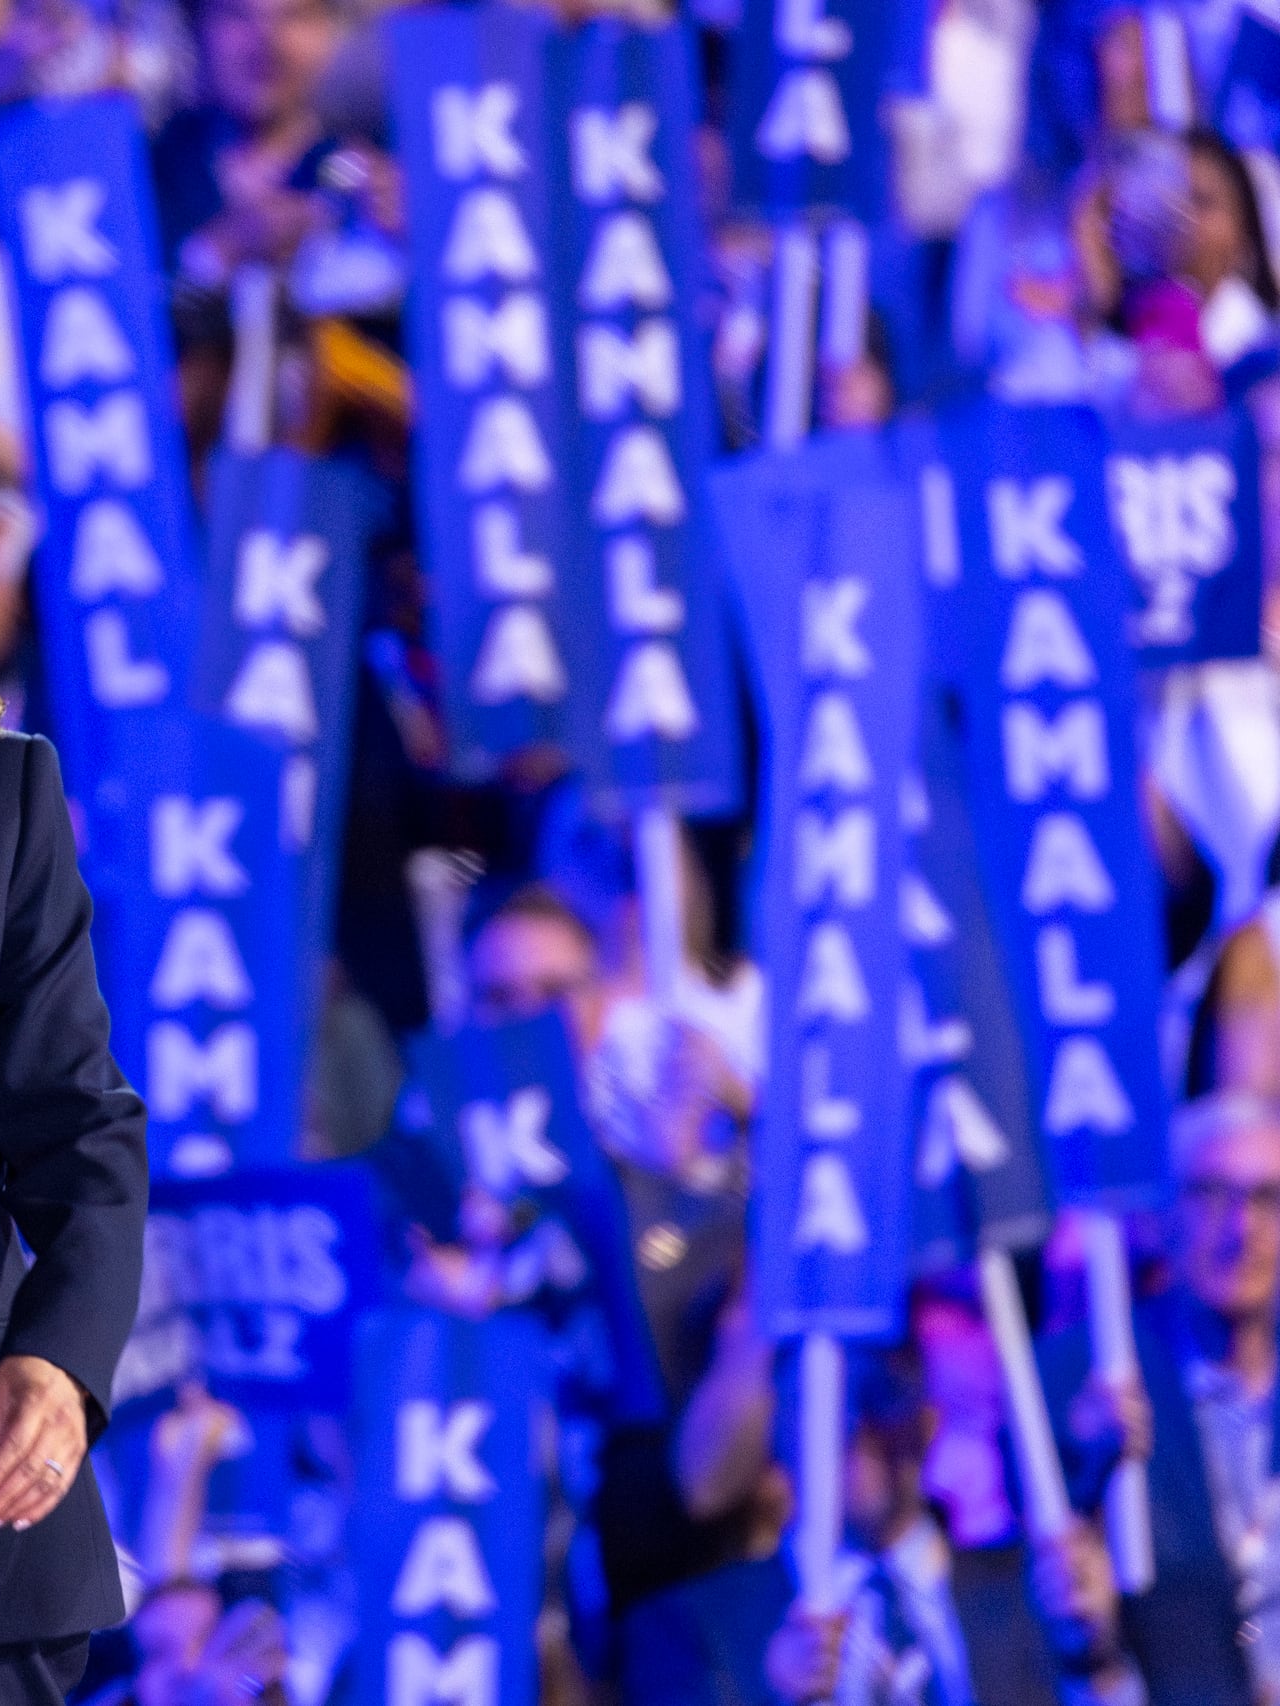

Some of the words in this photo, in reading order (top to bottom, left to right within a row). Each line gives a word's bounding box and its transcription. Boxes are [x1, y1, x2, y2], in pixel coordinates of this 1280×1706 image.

[432, 80, 565, 700] KAMALA
[572, 104, 698, 740] KAMALA
[794, 573, 878, 1256] KAMALA
[985, 473, 1134, 1134] KAMALA
